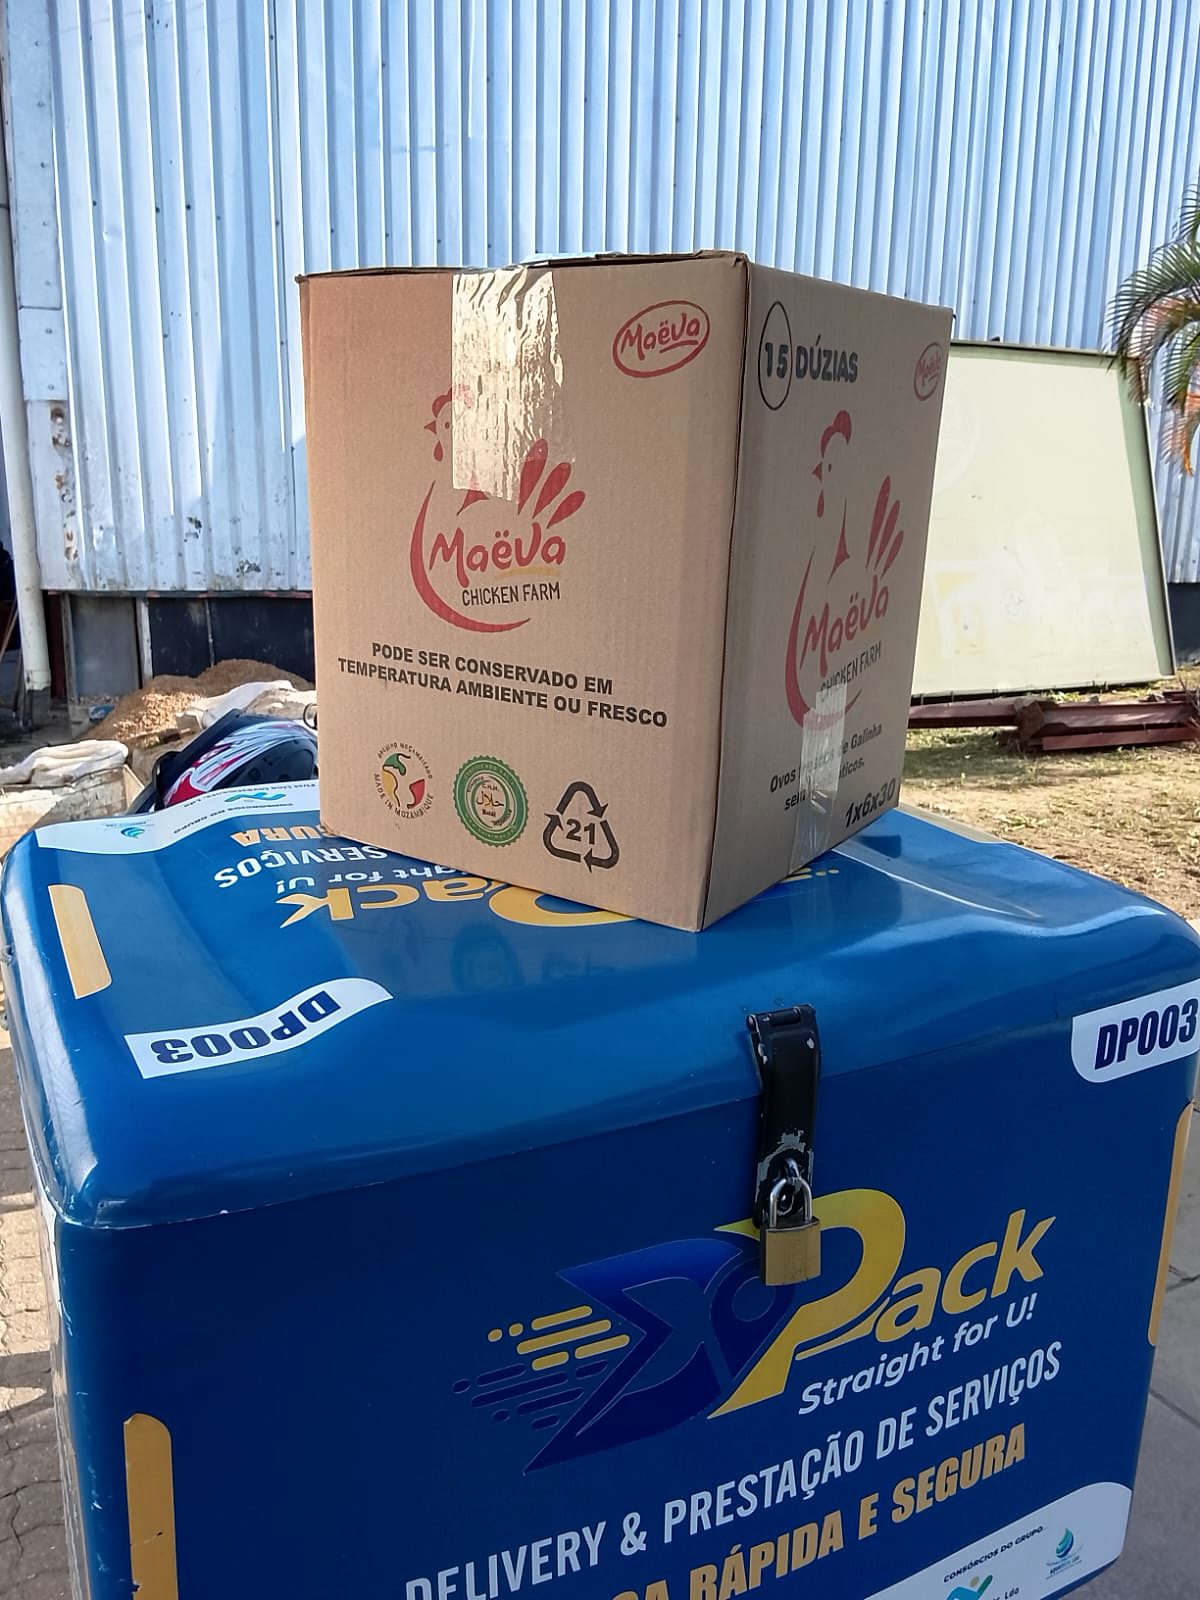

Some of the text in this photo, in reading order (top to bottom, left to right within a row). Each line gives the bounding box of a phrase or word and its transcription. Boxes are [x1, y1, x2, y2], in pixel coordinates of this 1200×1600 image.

[765, 334, 859, 383] 15 DÚZIAS
[461, 581, 561, 607] CHICKEN FARM
[372, 642, 613, 695] PODE SER CONSERVADO EM
[859, 640, 882, 673] FARM
[337, 657, 668, 728] TEMPERATURA AMBIENTE OU FRESCO
[769, 768, 796, 793] Ovos
[850, 723, 882, 750] Galinha
[374, 772, 386, 799] MADE
[384, 799, 394, 810] IN
[844, 777, 896, 829] 1x6x30
[566, 818, 597, 845] 21
[214, 845, 388, 888] SERVIÇOS
[276, 876, 316, 894] U!
[328, 870, 384, 883] for
[150, 990, 342, 1064] DP003
[1095, 998, 1199, 1070] DP003
[798, 1292, 1037, 1416] Straight for U!
[620, 1511, 647, 1556] &
[663, 1425, 864, 1545] PRESTAÇÃO
[876, 1414, 915, 1462] DE
[925, 1341, 1062, 1436] SERVIÇOS
[690, 1421, 1026, 1600] RÁPIDA E SEGURA
[943, 1525, 1045, 1583] CONSÓRCIOS DO GRUPO
